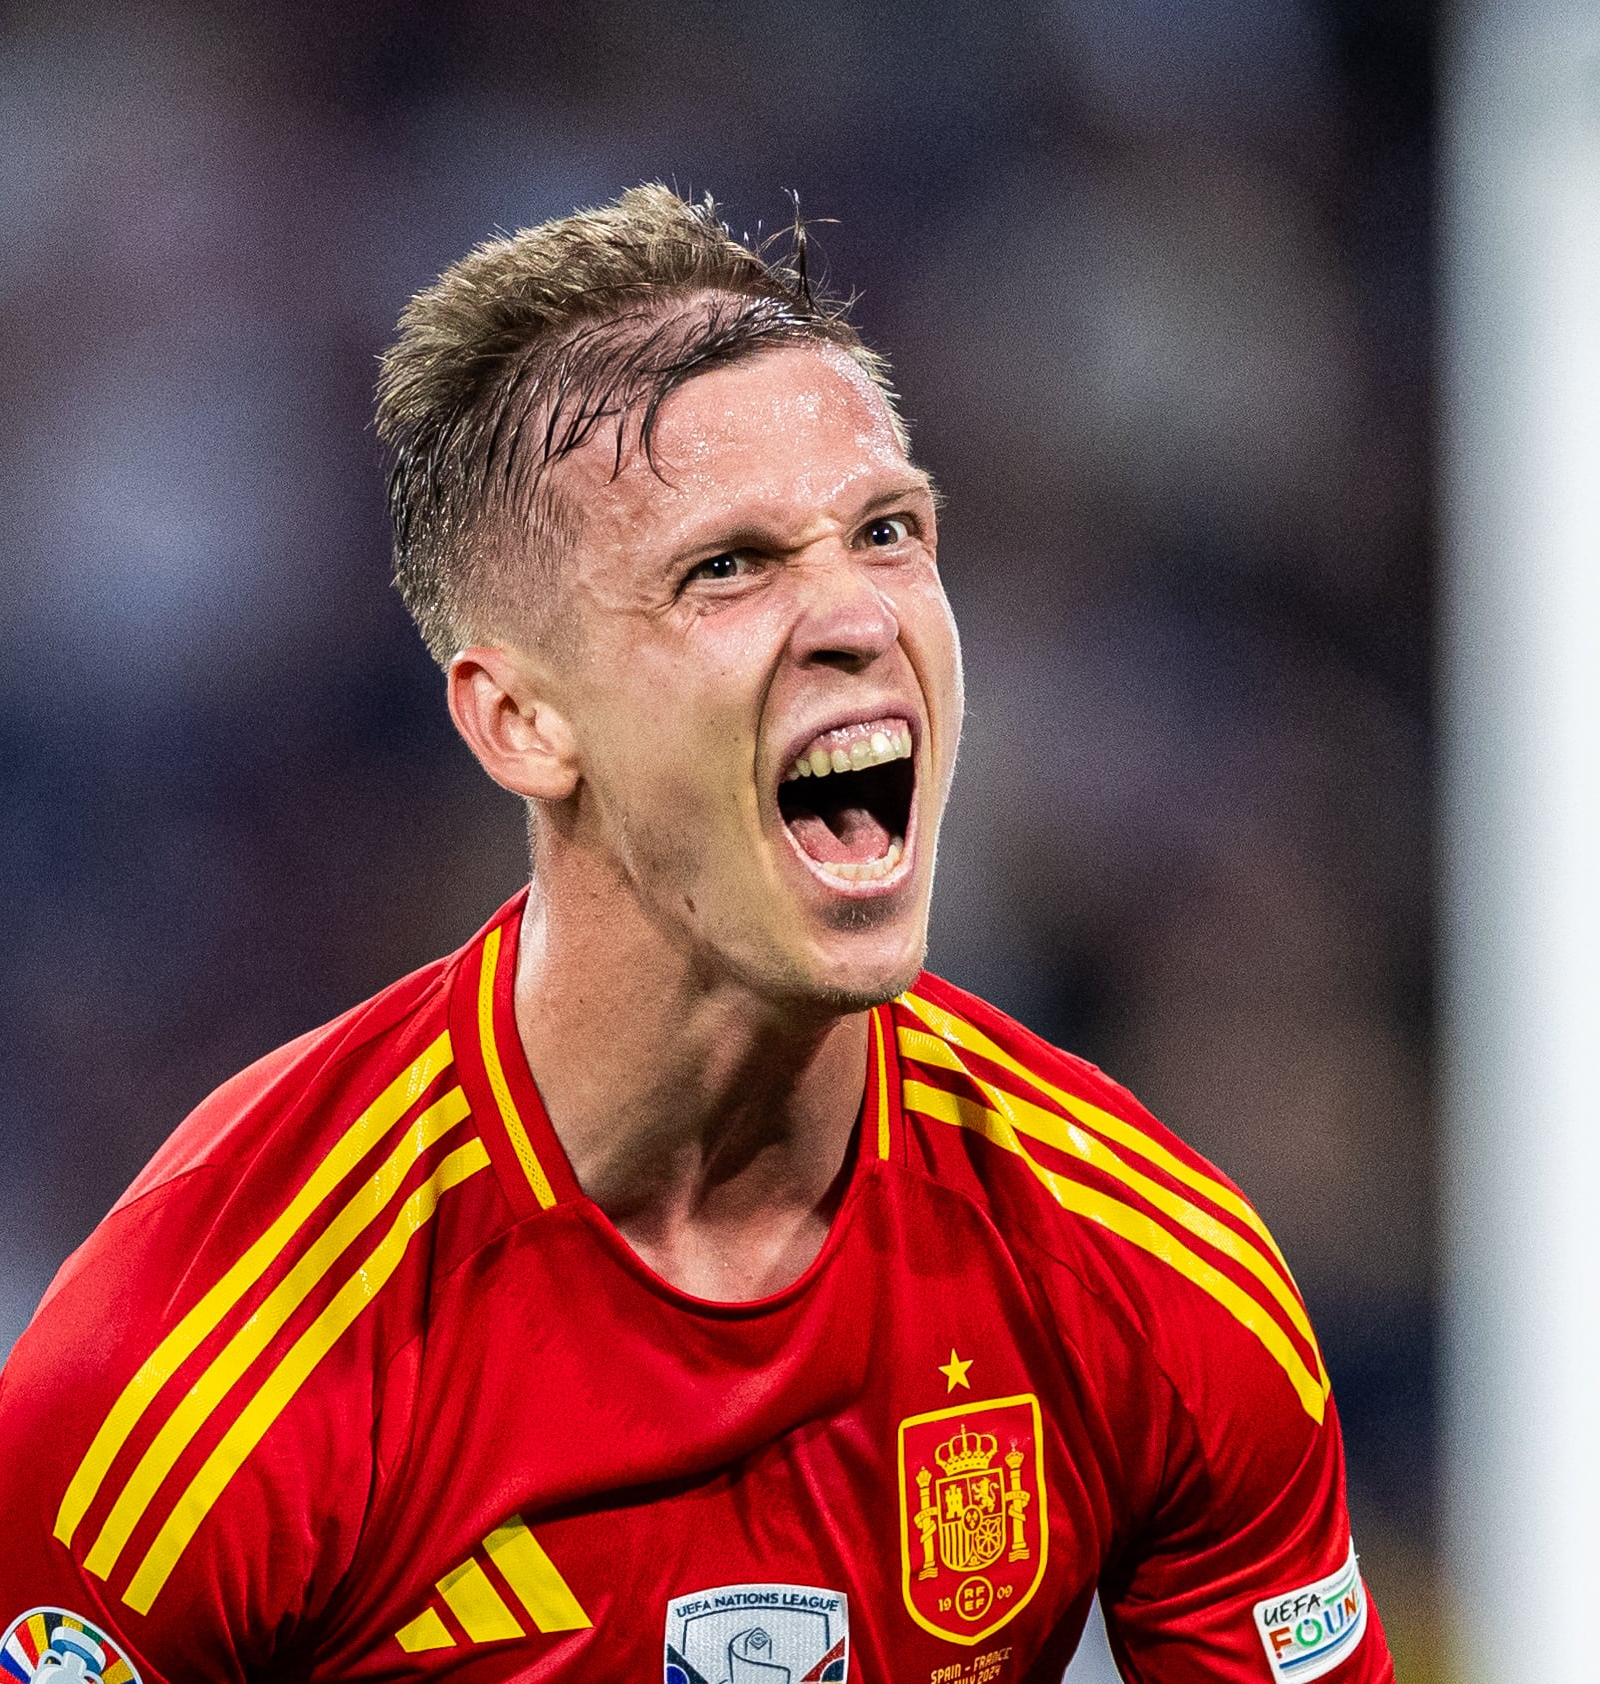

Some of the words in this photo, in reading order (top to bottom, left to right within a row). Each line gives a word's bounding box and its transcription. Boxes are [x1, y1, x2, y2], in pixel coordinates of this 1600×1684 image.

[675, 1602, 712, 1618] UEFA
[715, 1593, 779, 1606] NATIONS
[783, 1594, 840, 1612] LEAGUE
[938, 1597, 952, 1612] 19
[997, 1585, 1013, 1599] 09
[1264, 1593, 1321, 1626] UEFA
[973, 1646, 1012, 1672] FRANCE
